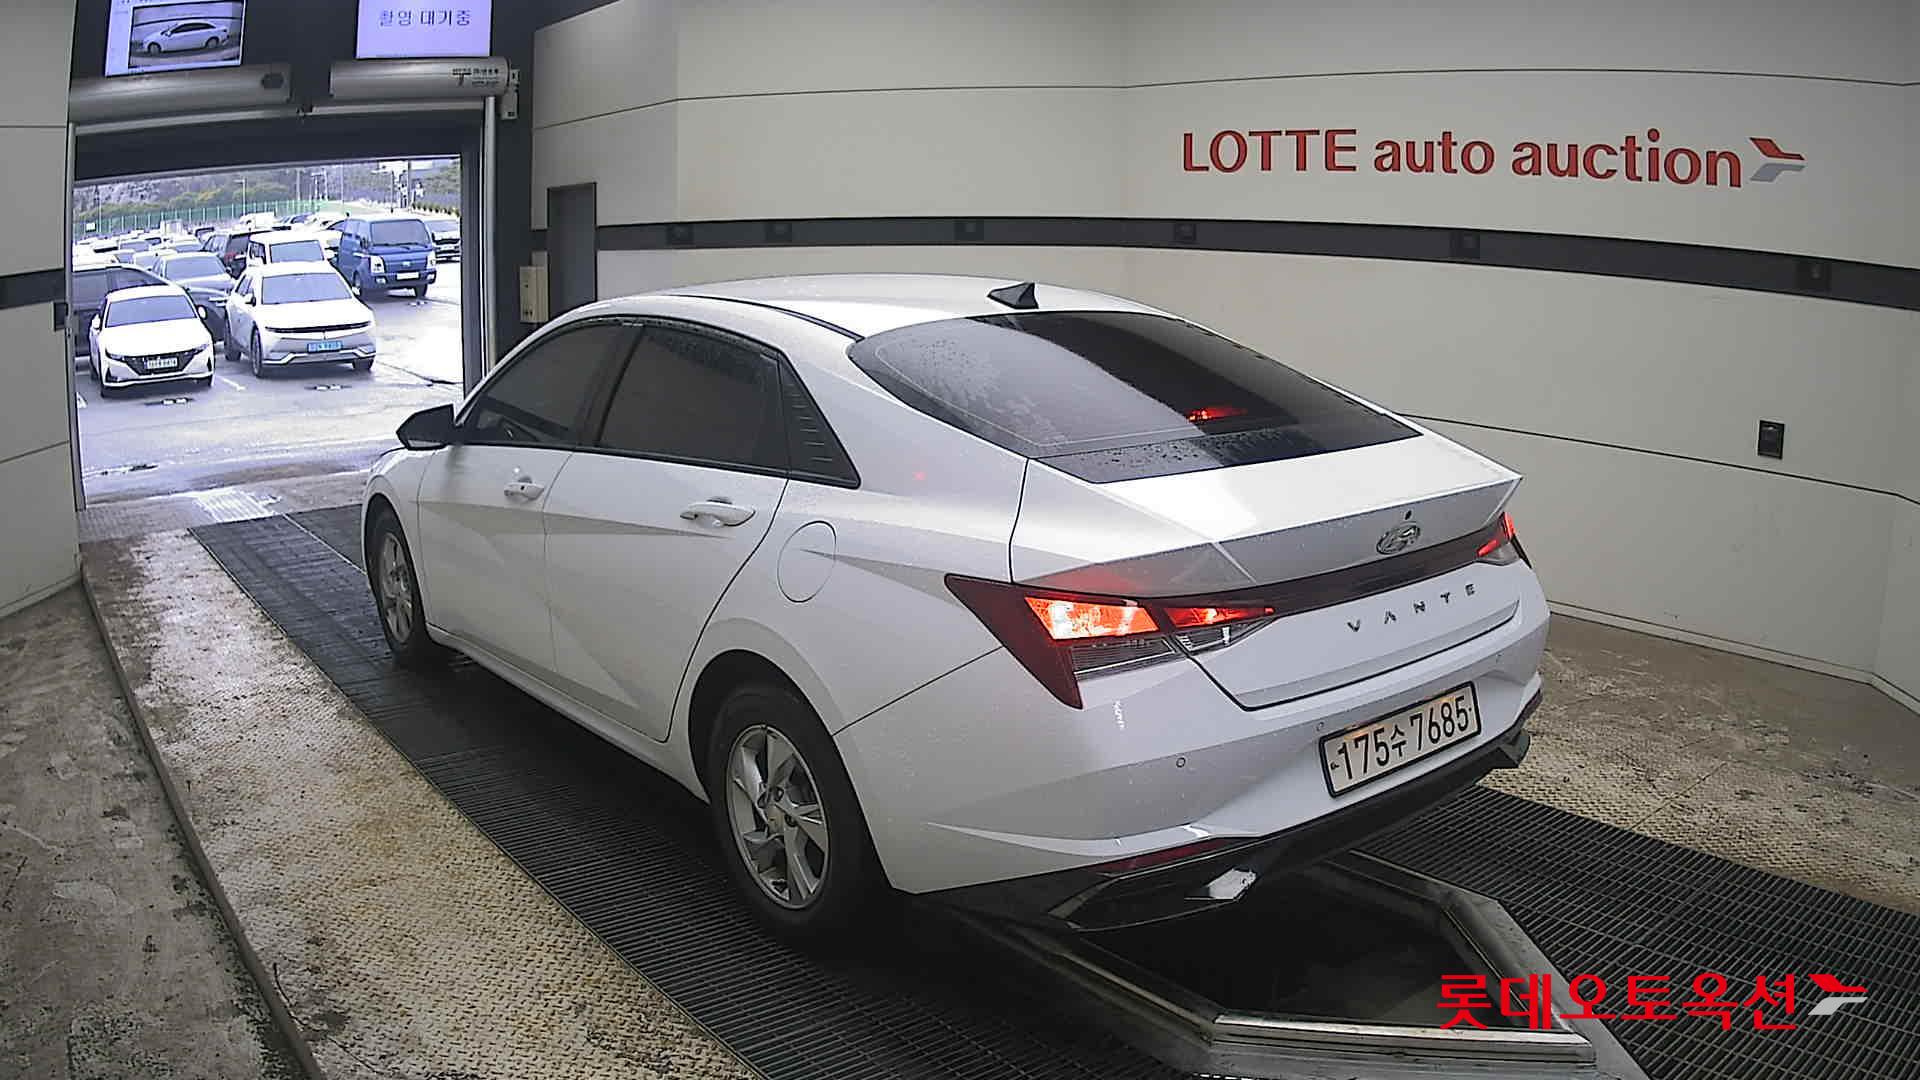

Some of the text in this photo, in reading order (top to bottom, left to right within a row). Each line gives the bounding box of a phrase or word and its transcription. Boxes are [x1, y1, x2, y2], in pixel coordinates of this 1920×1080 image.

[1183, 129, 1743, 188] LOTTE auto auction
